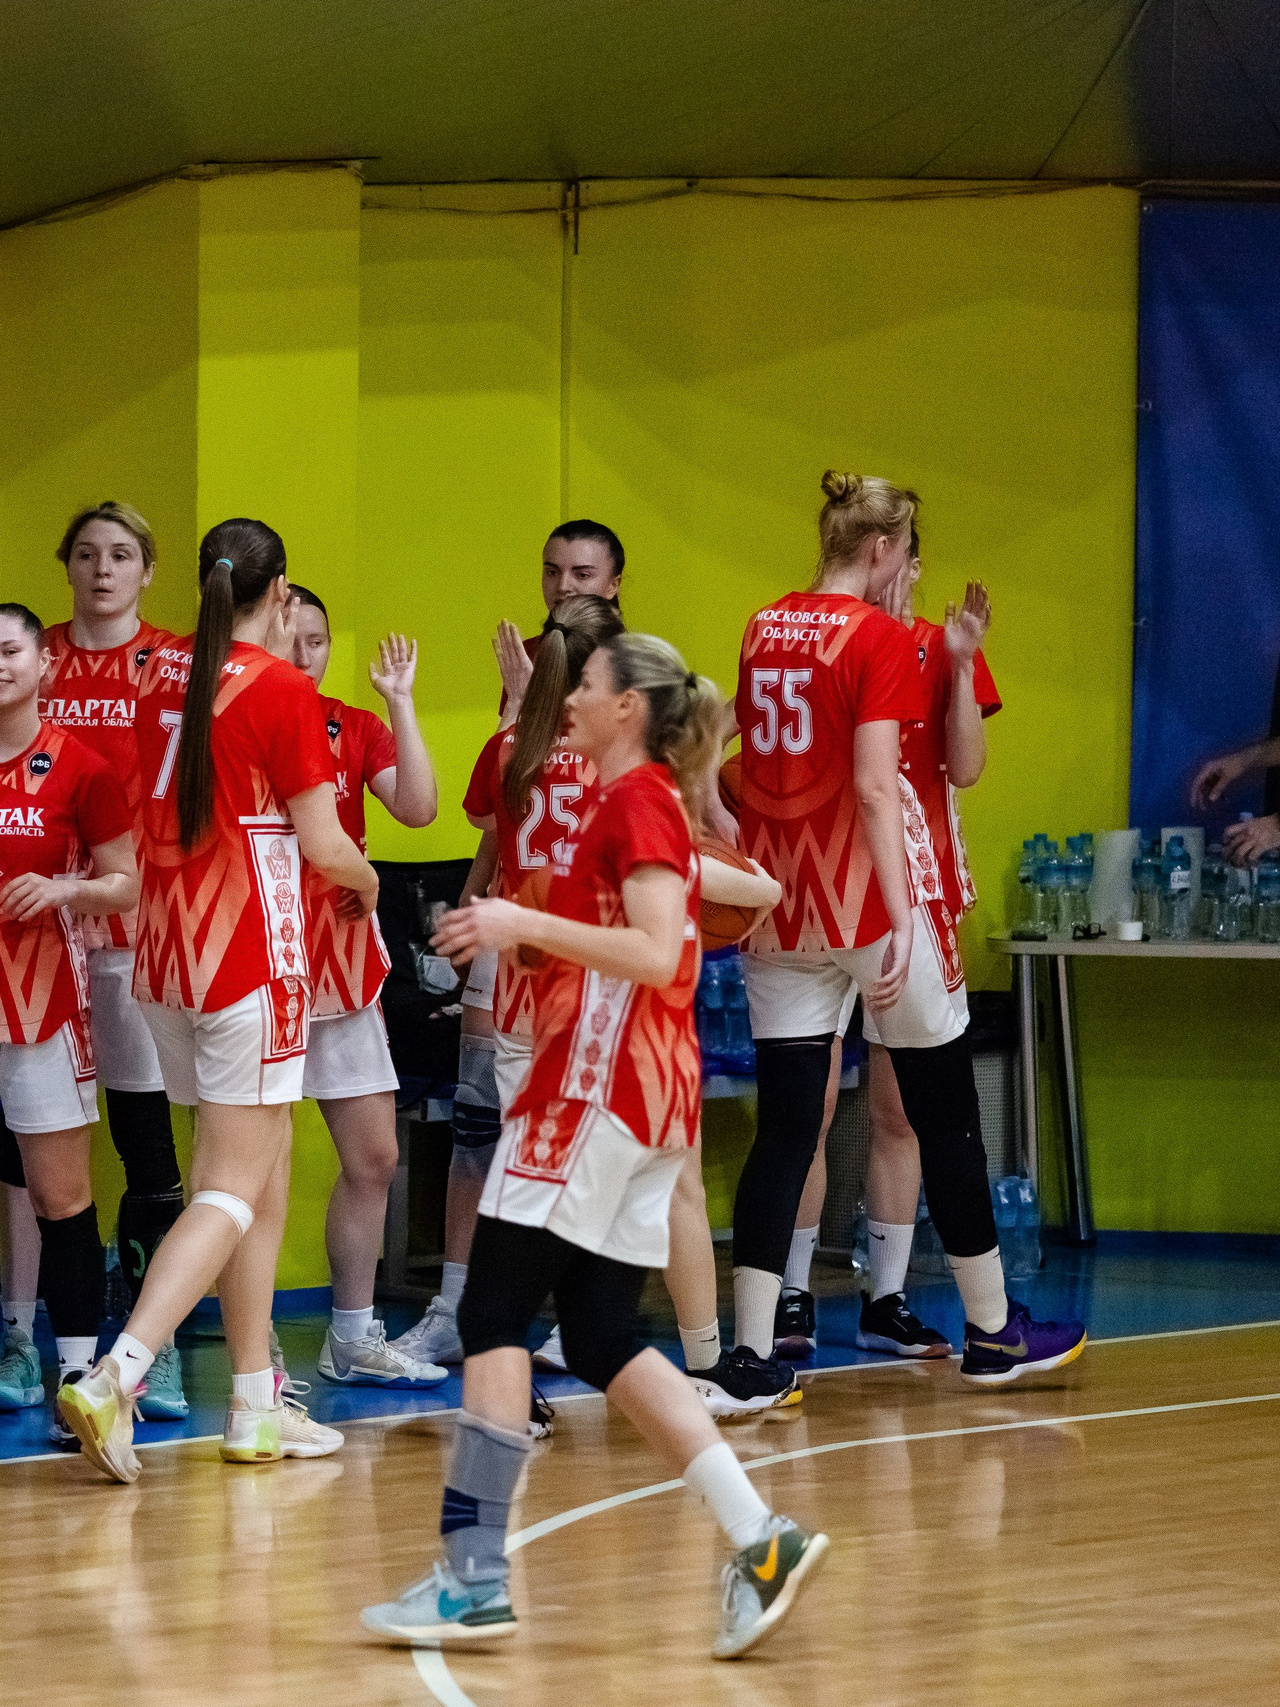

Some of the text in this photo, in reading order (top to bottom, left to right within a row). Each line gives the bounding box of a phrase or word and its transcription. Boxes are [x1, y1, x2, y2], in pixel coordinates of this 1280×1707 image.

[754, 609, 848, 626] МОСКОВСКАЯ
[762, 626, 821, 641] ОБЛАСТЬ
[751, 667, 813, 755] 55
[31, 759, 51, 769] РФБ
[516, 783, 583, 870] 25
